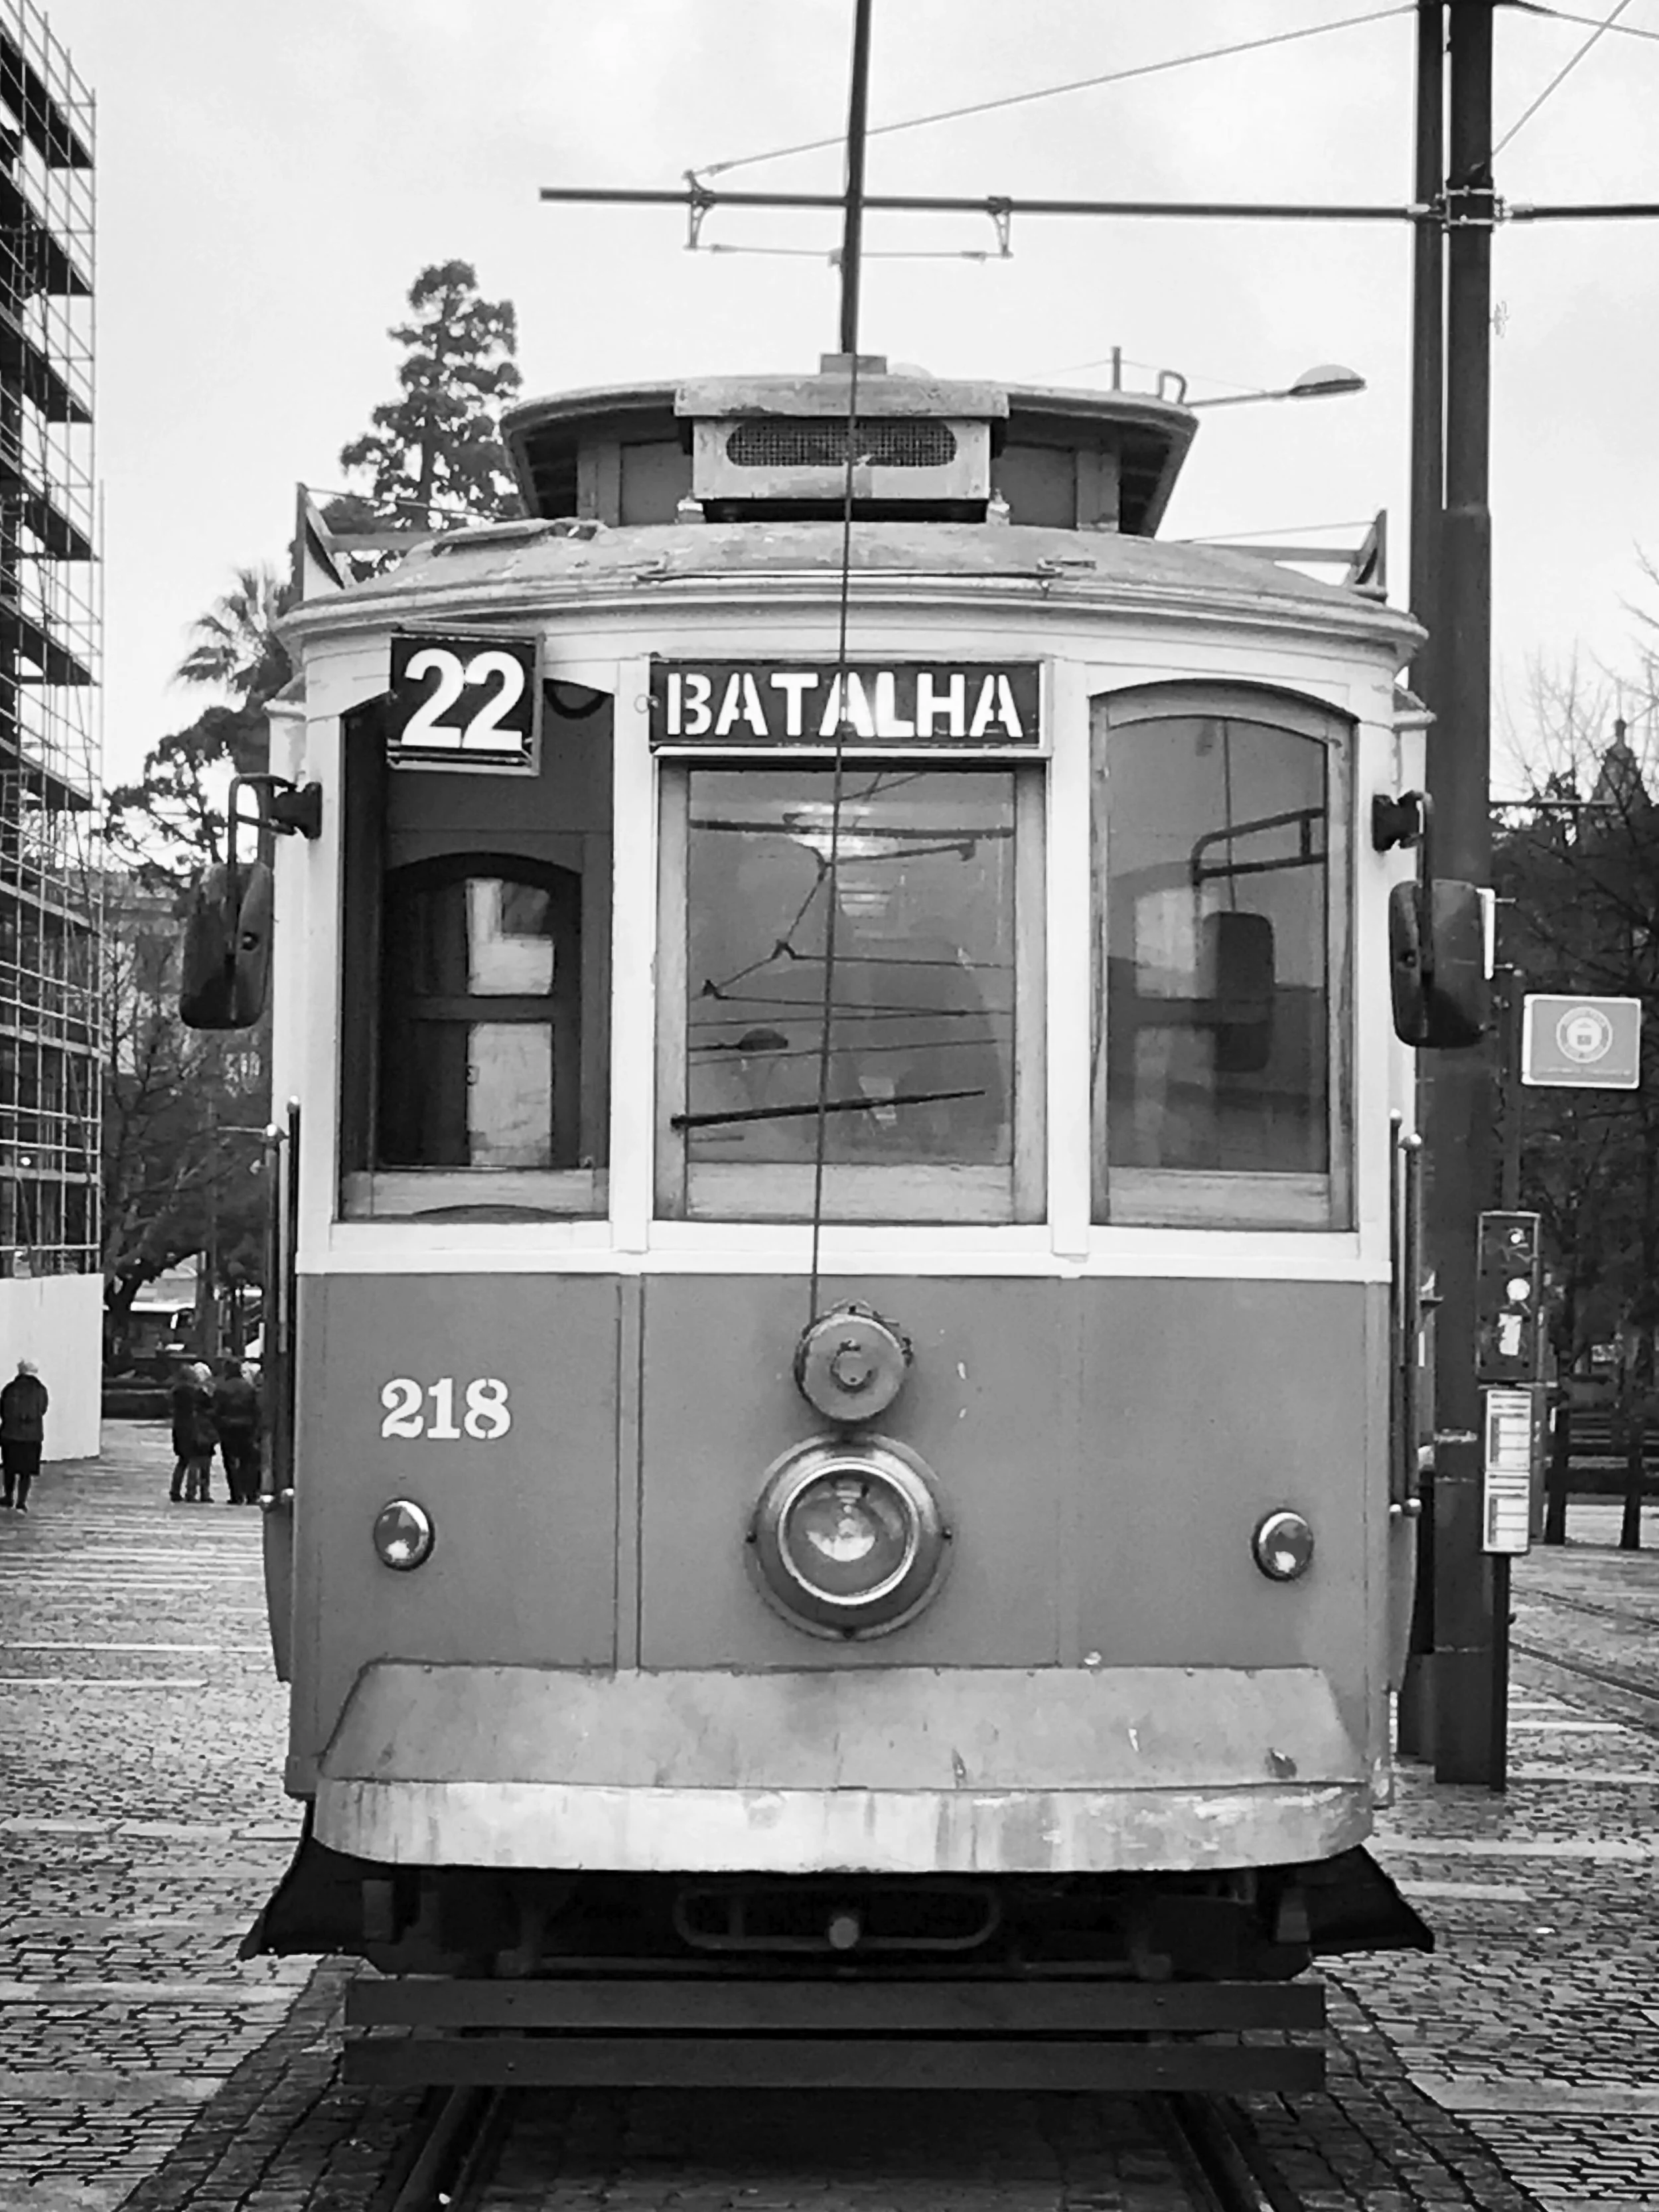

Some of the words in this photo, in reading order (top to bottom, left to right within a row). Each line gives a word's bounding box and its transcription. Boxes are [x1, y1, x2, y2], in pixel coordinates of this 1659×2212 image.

[401, 648, 524, 751] 22
[667, 672, 1023, 738] BATALHA
[382, 1378, 510, 1439] 218
